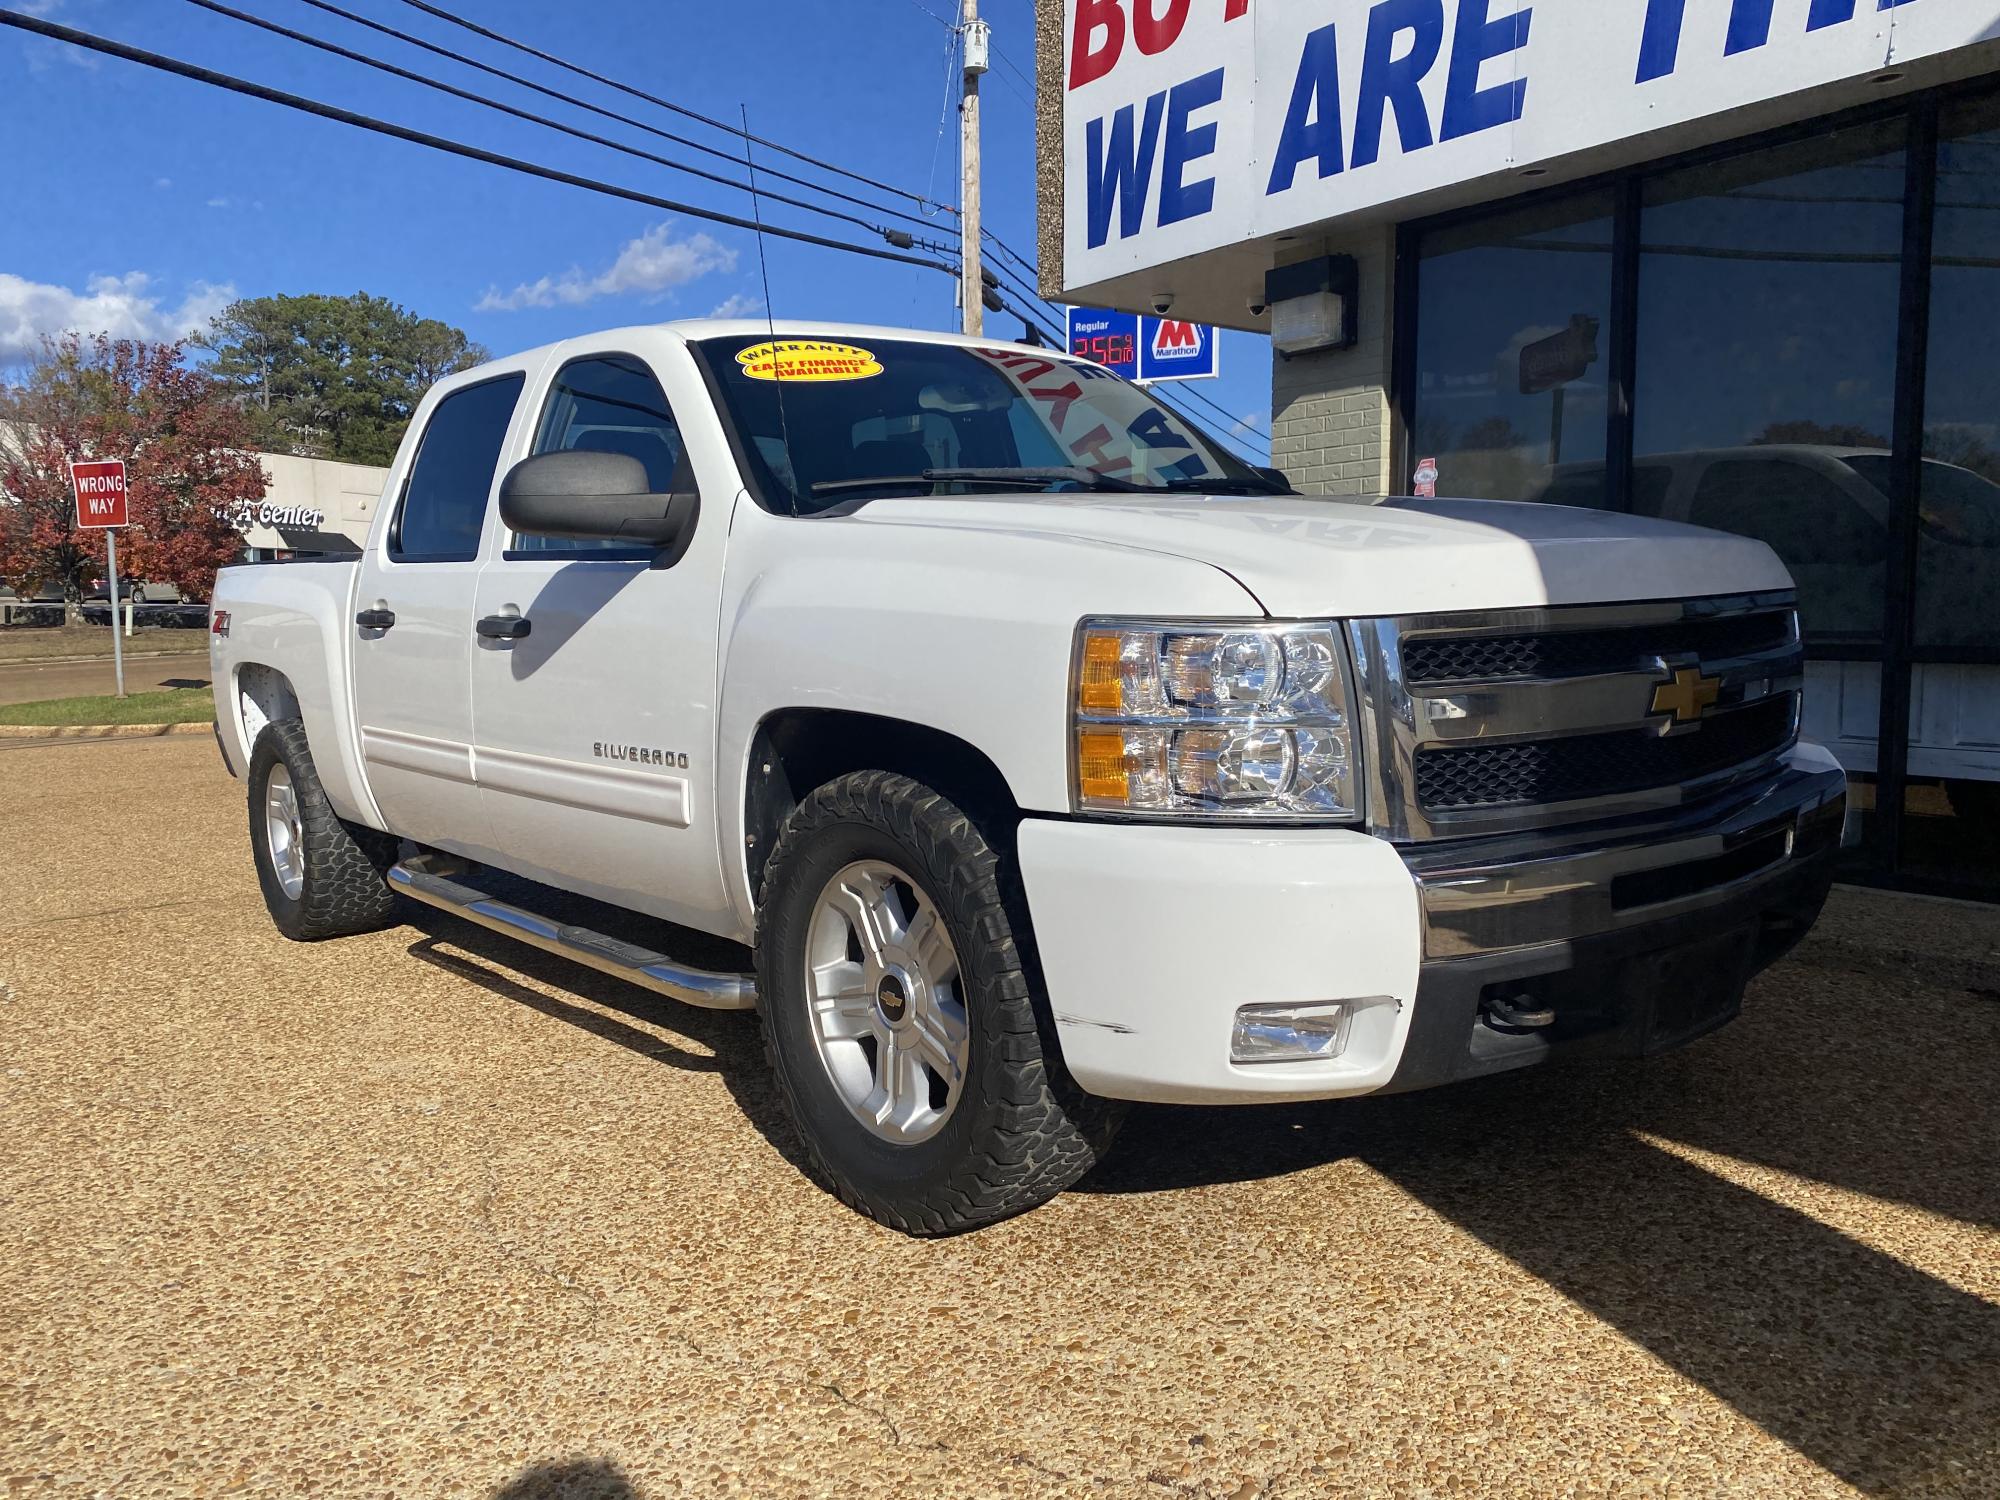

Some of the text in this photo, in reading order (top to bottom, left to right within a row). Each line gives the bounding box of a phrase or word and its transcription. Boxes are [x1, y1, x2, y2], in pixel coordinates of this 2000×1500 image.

[1085, 66, 1225, 250] WE
[1266, 0, 1533, 196] ARE
[1075, 321, 1109, 333] Regular
[743, 344, 862, 360] WARRANTY
[1156, 347, 1197, 356] Marathon
[752, 359, 868, 372] EASY FINANCE
[774, 366, 861, 377] AVAILABLE
[78, 475, 123, 493] WRONG
[88, 498, 115, 514] WAY
[260, 503, 321, 526] Center
[593, 742, 689, 769] SILVERADO
